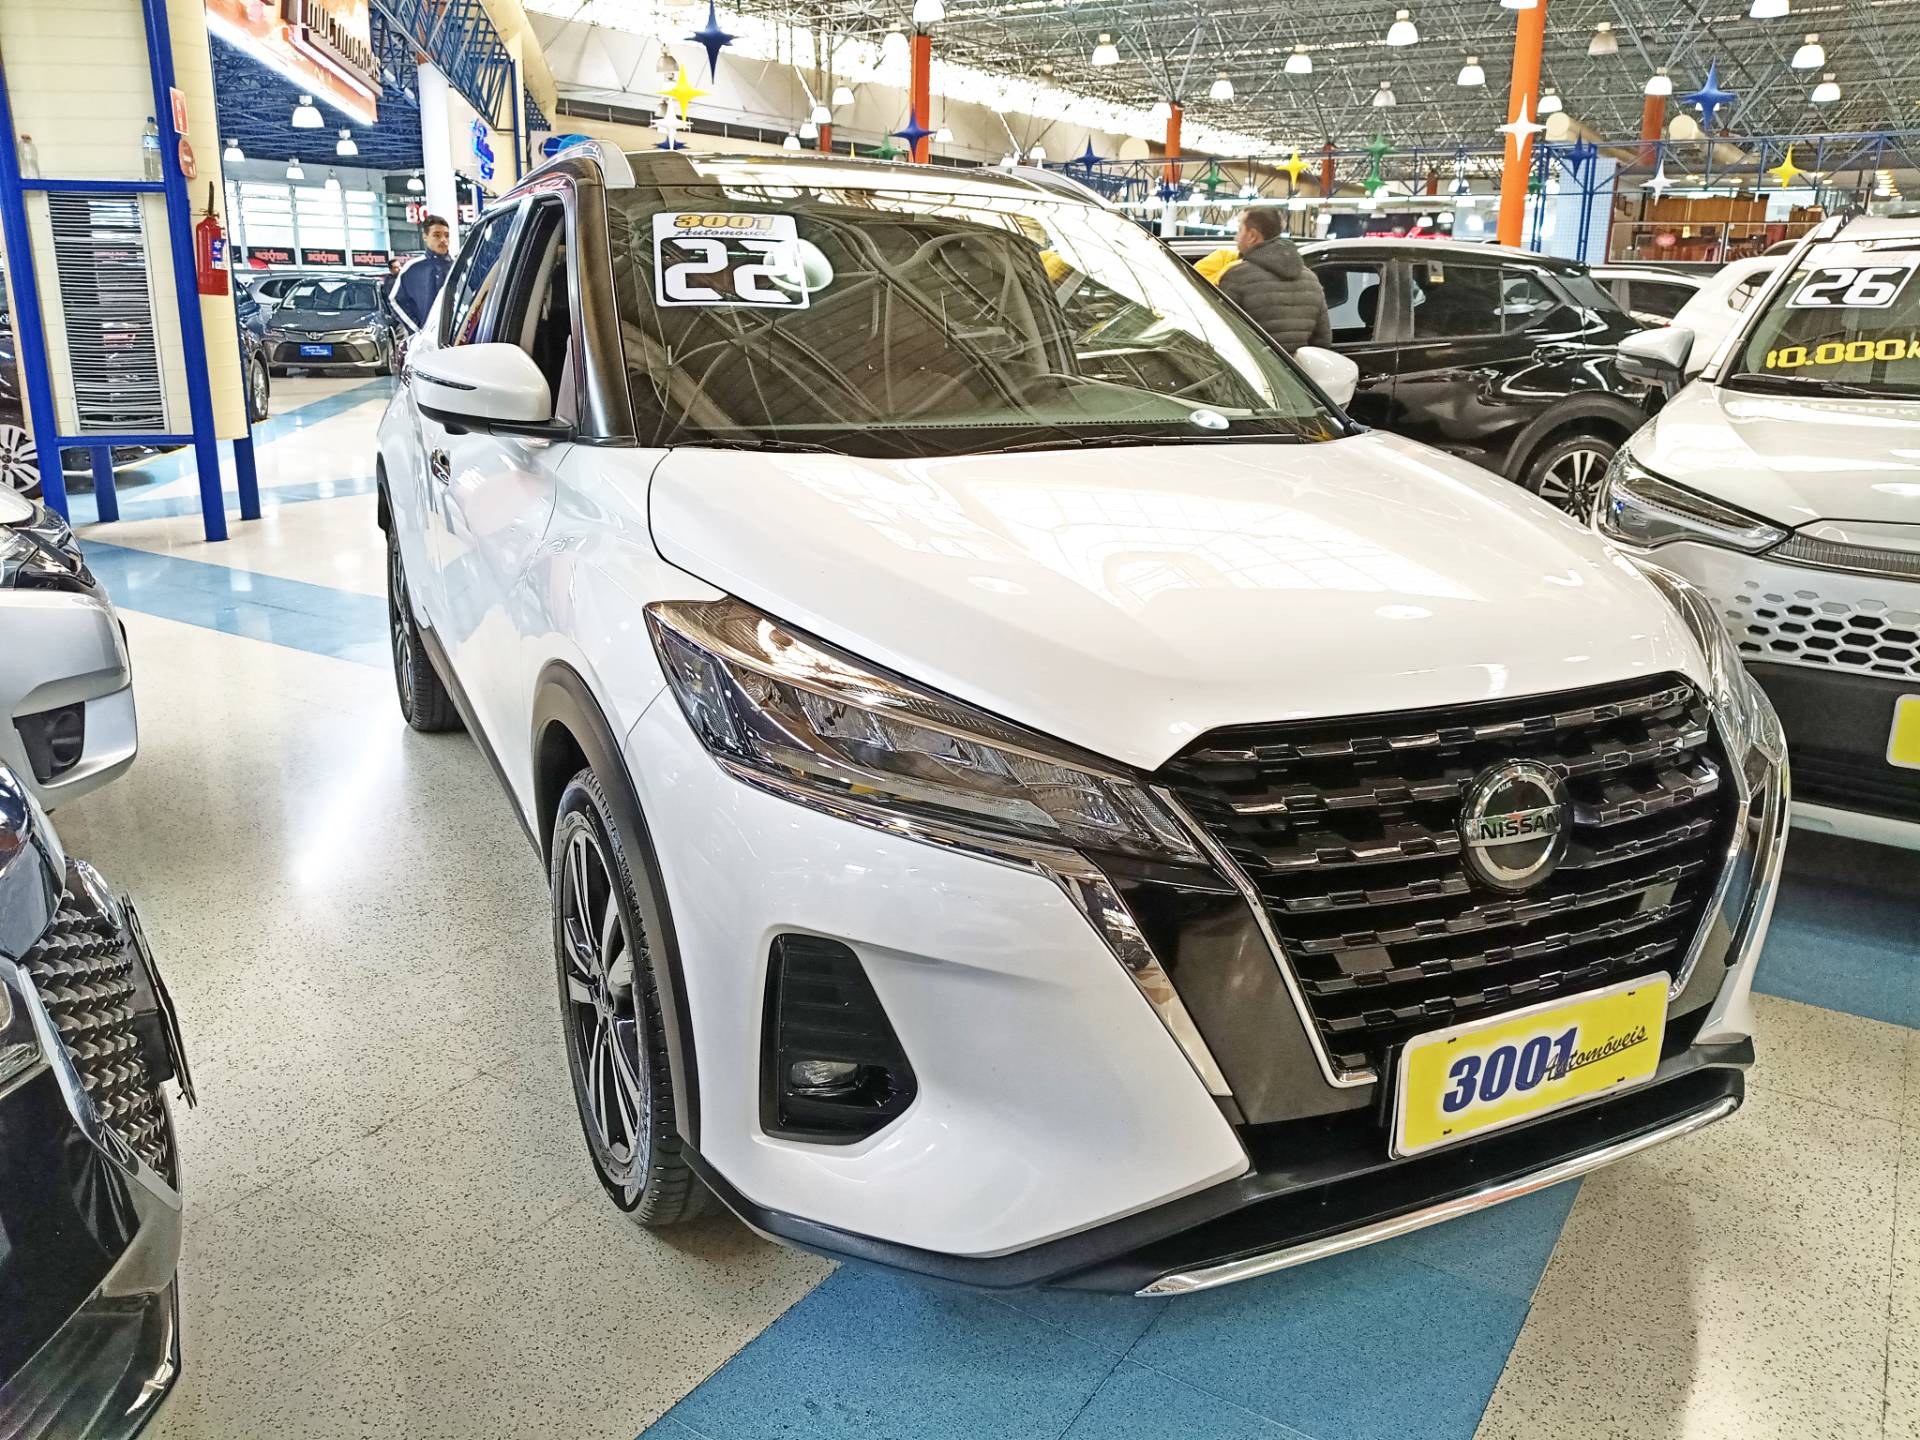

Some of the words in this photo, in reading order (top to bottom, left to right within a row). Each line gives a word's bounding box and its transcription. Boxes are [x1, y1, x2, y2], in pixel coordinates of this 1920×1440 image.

[673, 214, 775, 231] 3001
[664, 238, 797, 303] 22
[1795, 267, 1904, 305] 26
[1480, 813, 1557, 840] NISSAN
[1442, 1026, 1578, 1113] 3001
